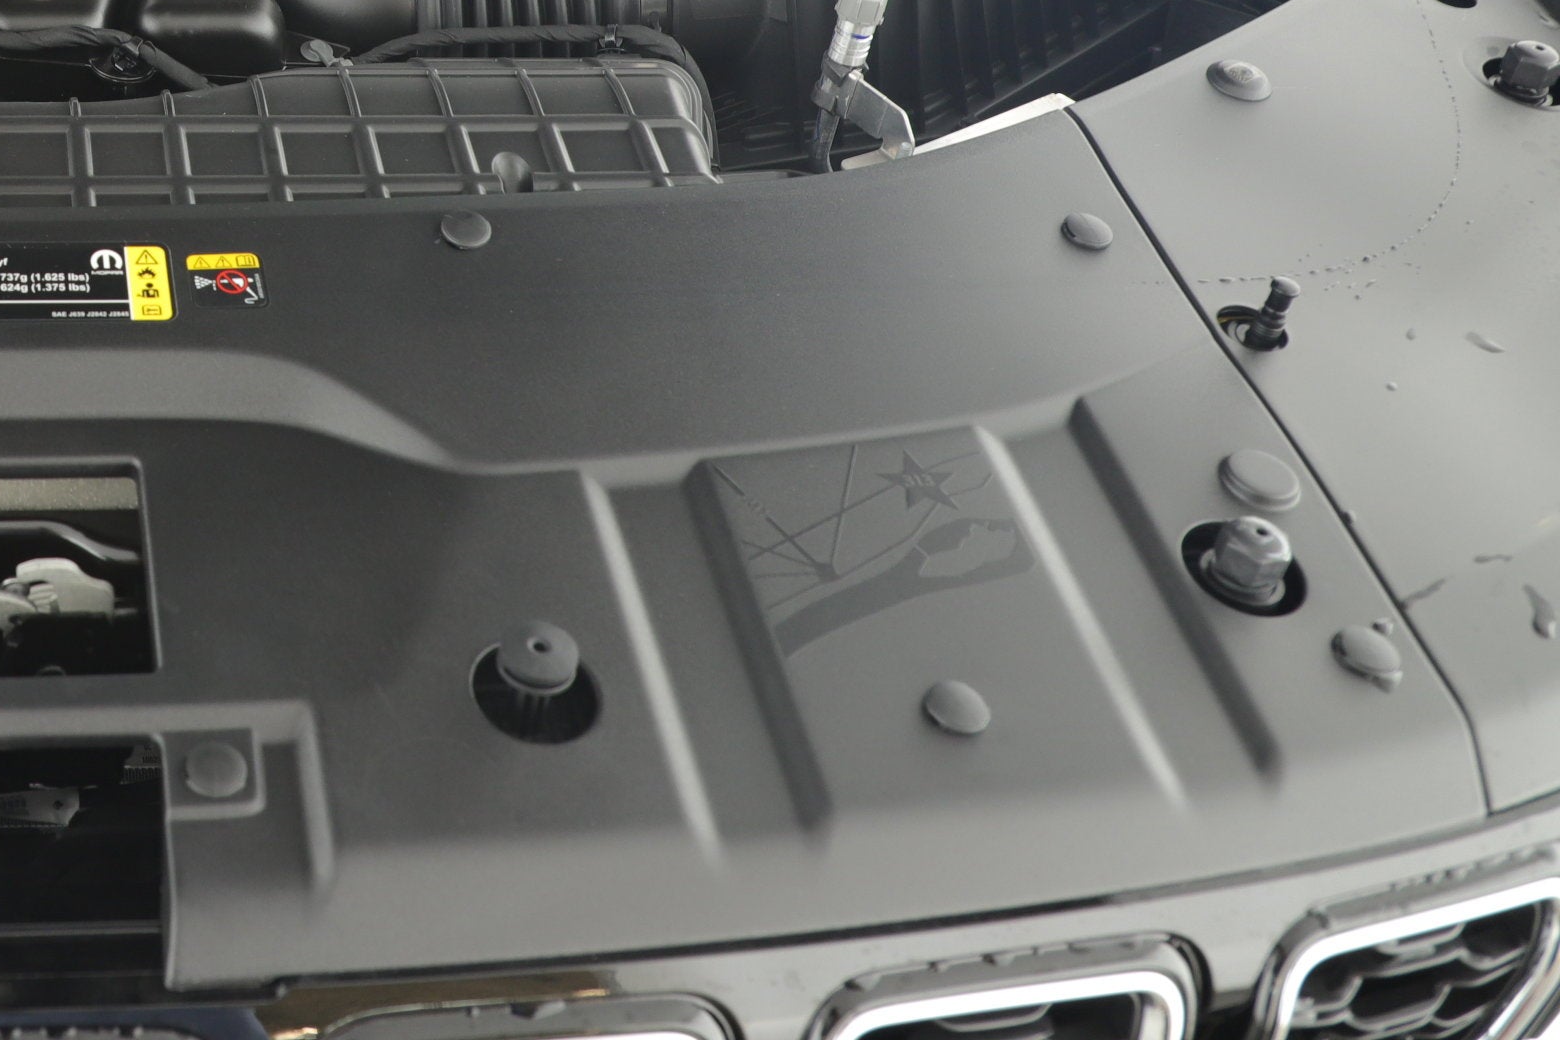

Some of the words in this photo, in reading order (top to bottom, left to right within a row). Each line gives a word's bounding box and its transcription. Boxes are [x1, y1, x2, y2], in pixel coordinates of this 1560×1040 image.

[0, 273, 28, 283] 737g
[30, 272, 65, 283] (1.625
[68, 272, 90, 283] lbs)
[0, 283, 28, 294] 624g
[30, 283, 65, 293] (1.375
[68, 283, 91, 293] lbs)
